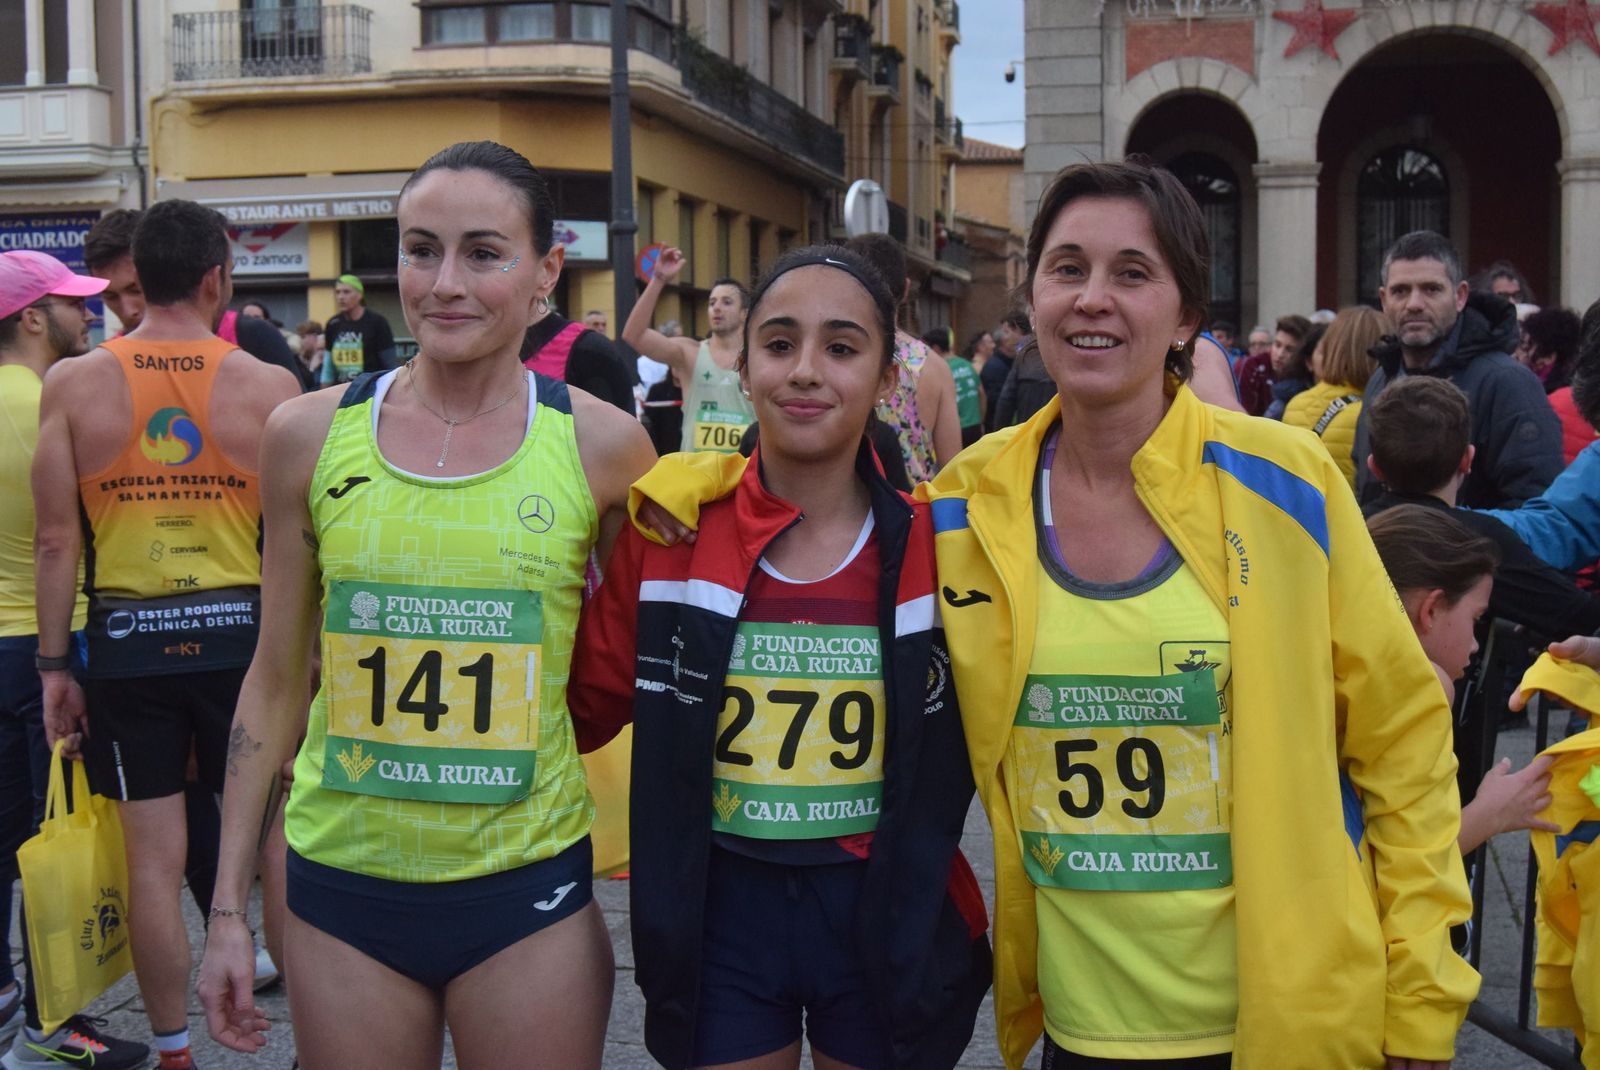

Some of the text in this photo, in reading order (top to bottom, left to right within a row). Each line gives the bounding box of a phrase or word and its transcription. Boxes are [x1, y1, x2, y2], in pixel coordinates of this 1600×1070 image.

[333, 201, 392, 216] METRO
[253, 253, 303, 267] zamora
[134, 354, 205, 372] SANTOS
[336, 350, 359, 362] 418
[700, 426, 741, 447] 706
[100, 475, 165, 491] ESCUELA
[118, 491, 222, 502] SALMANTINA
[499, 547, 560, 569] Mercedes Benz
[516, 563, 545, 578] Adarsa
[138, 602, 253, 620] ESTER RODRÍGUEZ
[385, 595, 514, 619] FUNDACION
[138, 615, 254, 632] CLÍNICA DENTAL
[385, 615, 513, 637] CAJA RURAL
[751, 634, 879, 656] FUNDACION
[751, 654, 878, 674] CAJA RURAL
[358, 646, 494, 734] 141
[1058, 686, 1184, 705] FUNDACION
[1060, 704, 1187, 723] CAJA RURAL
[715, 686, 875, 770] 279
[378, 759, 522, 786] CAJA RURAL
[1054, 737, 1166, 818] 59
[743, 797, 880, 823] CAJA RURAL
[1067, 851, 1218, 873] CAJA RURAL
